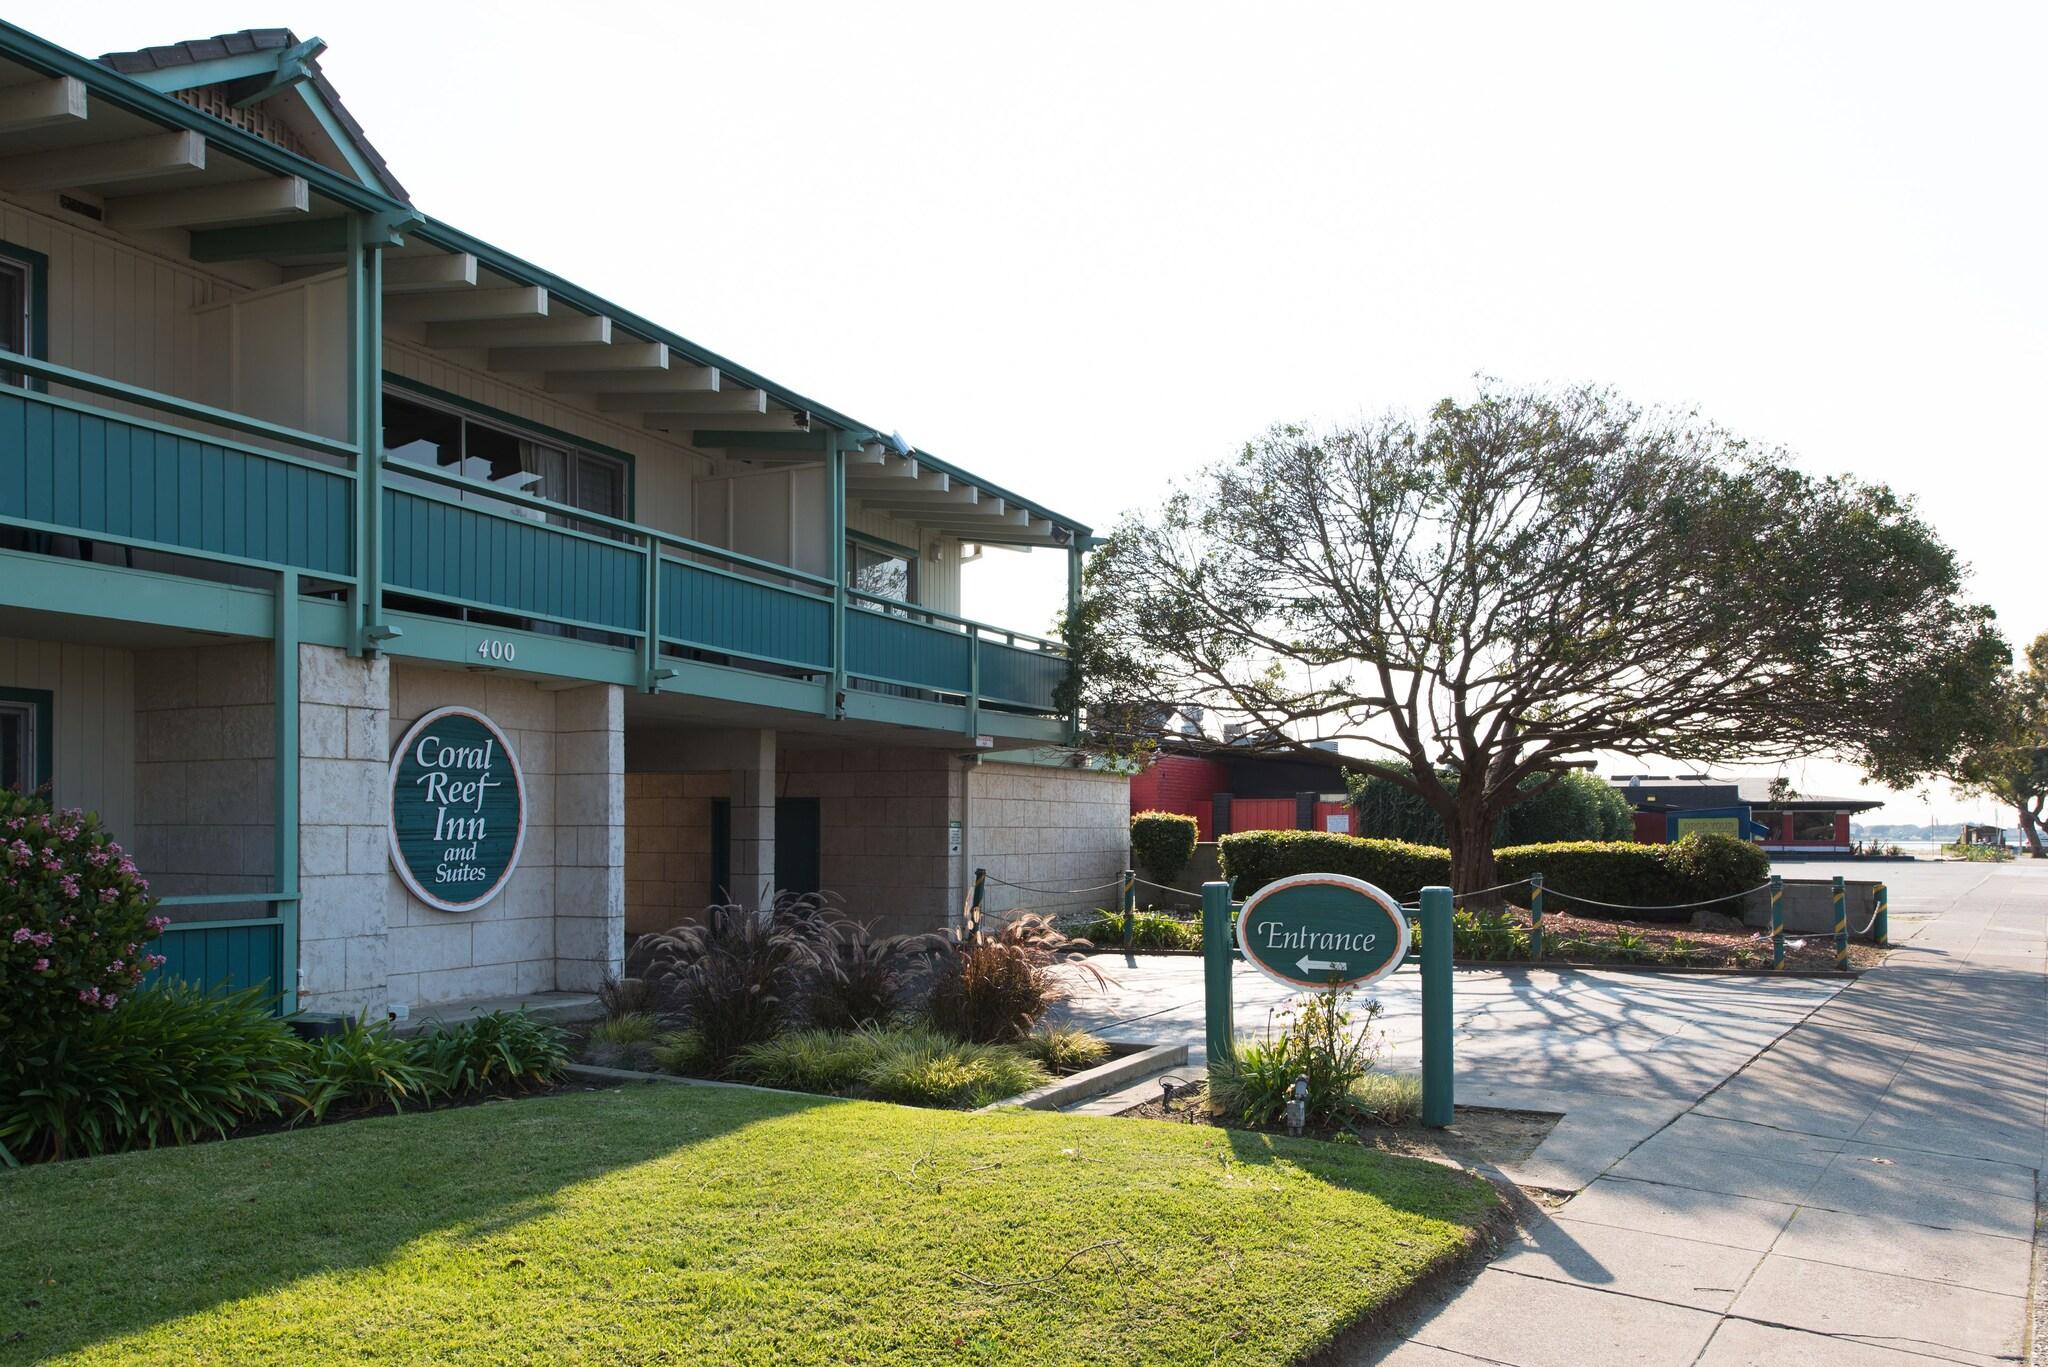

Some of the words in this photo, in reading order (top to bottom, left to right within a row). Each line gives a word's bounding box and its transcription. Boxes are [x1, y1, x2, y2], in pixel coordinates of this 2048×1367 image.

[478, 639, 515, 662] 400
[416, 735, 493, 769] Coral
[416, 771, 501, 814] Reef
[433, 806, 487, 841] Inn
[443, 842, 478, 862] and
[435, 862, 486, 884] Suites
[1257, 921, 1376, 952] Entrance
